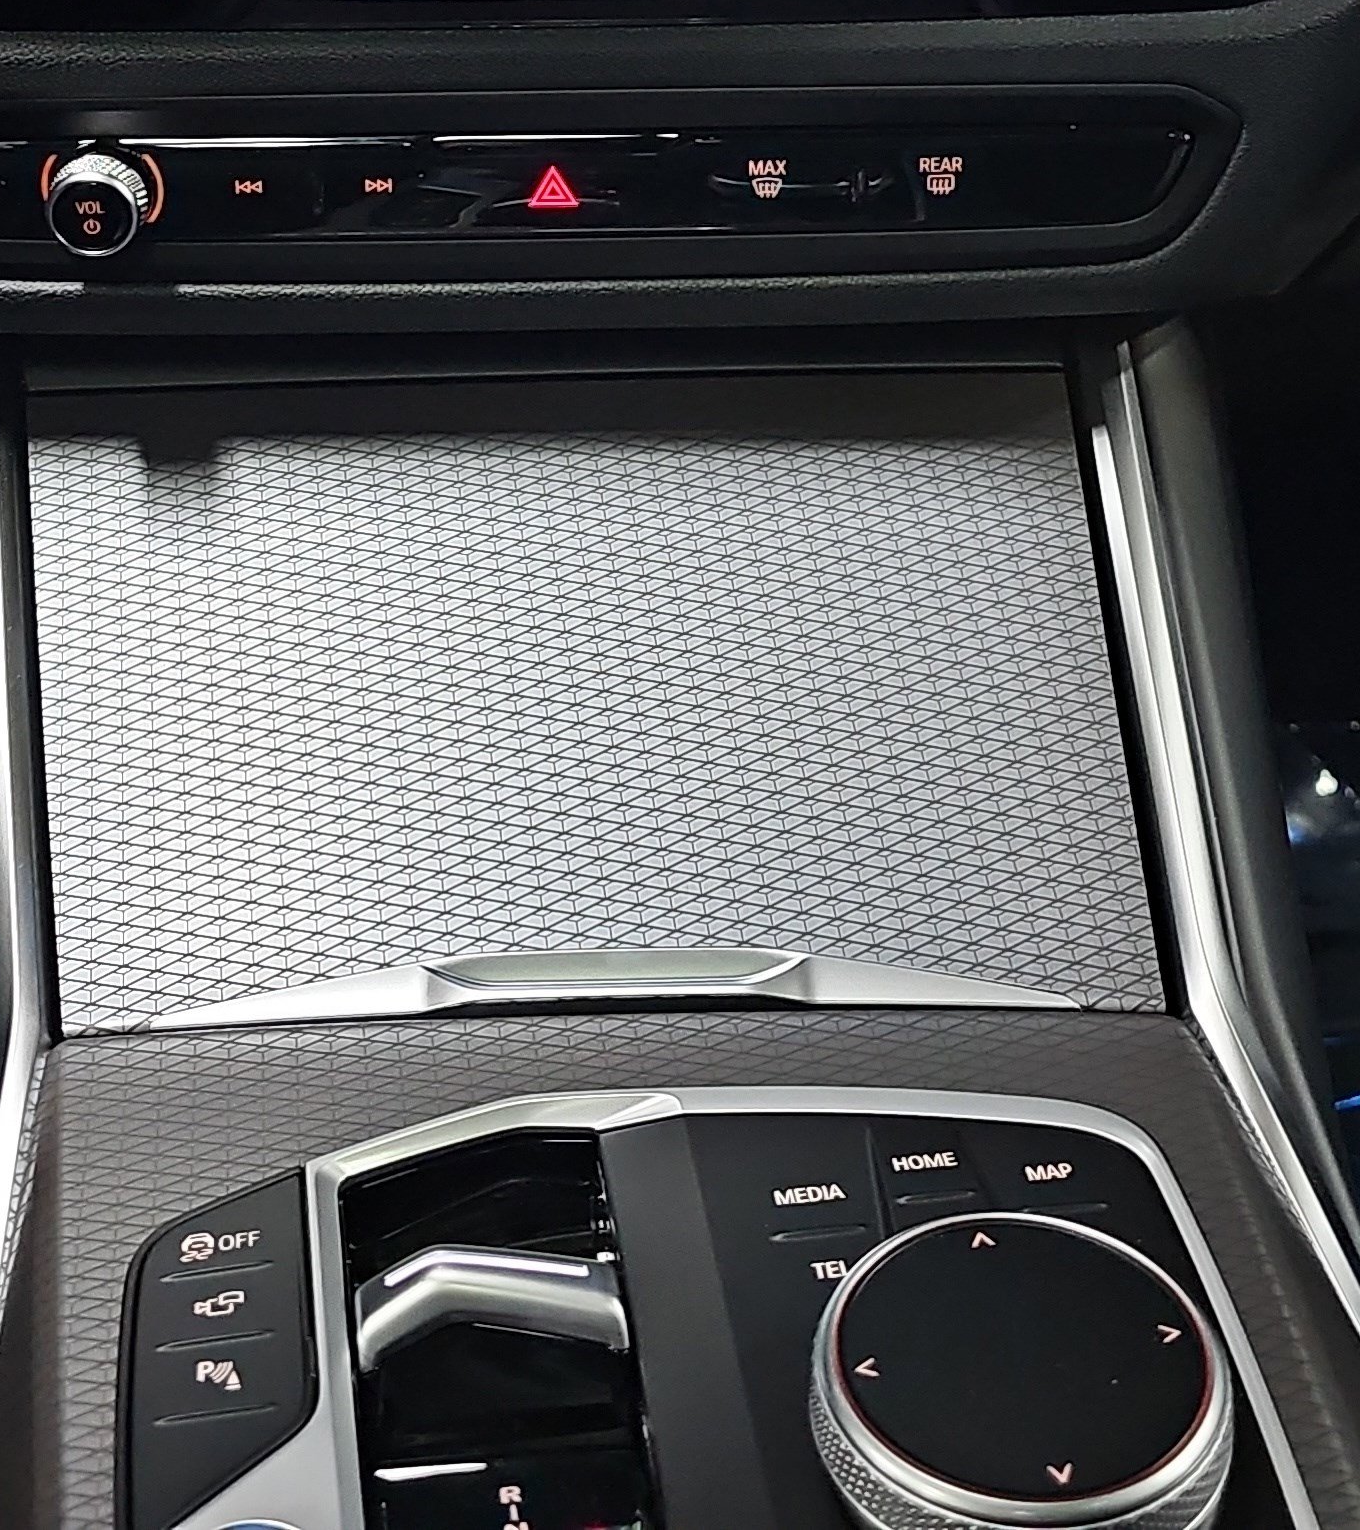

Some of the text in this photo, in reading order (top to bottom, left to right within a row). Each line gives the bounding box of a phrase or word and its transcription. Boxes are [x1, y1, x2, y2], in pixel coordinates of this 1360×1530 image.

[748, 159, 787, 176] MAX
[919, 156, 963, 173] REAR
[75, 201, 106, 215] VOL
[891, 1152, 958, 1172] HOME
[1024, 1162, 1073, 1182] MAP
[773, 1183, 846, 1206] MEDIA
[218, 1230, 261, 1251] OFF
